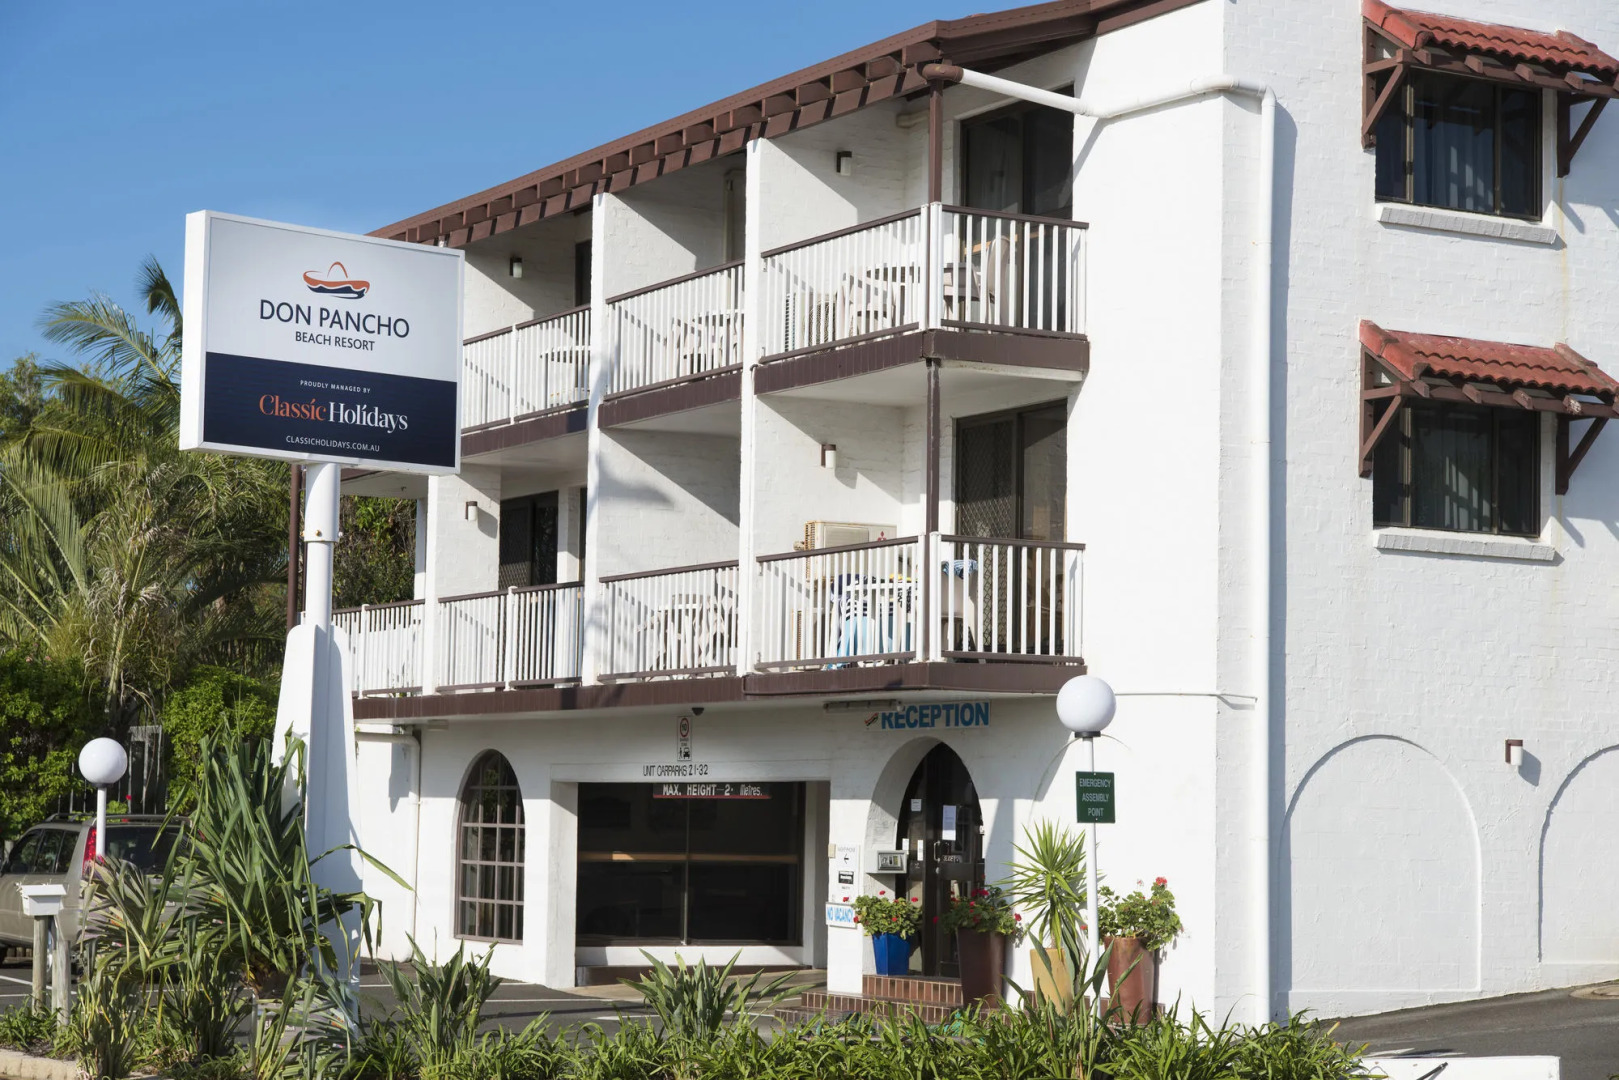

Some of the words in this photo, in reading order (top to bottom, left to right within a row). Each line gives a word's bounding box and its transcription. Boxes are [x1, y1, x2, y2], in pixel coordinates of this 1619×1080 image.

[260, 299, 311, 326] DON
[319, 307, 410, 338] PANCHO
[295, 331, 332, 346] BEACH
[334, 336, 376, 352] RESORT
[300, 379, 329, 389] PROUDLY
[330, 383, 361, 393] MANAGED
[285, 435, 380, 452] CLASSICHOLIDAYS.COM.AU
[881, 702, 989, 729] RECEPTION
[643, 765, 655, 777] UNIT
[662, 784, 682, 796] MAX.
[1079, 778, 1111, 788] EMERGENCY
[1081, 792, 1109, 802] ASSEMBLY
[1087, 807, 1104, 817] POINT
[827, 906, 833, 920] NO
